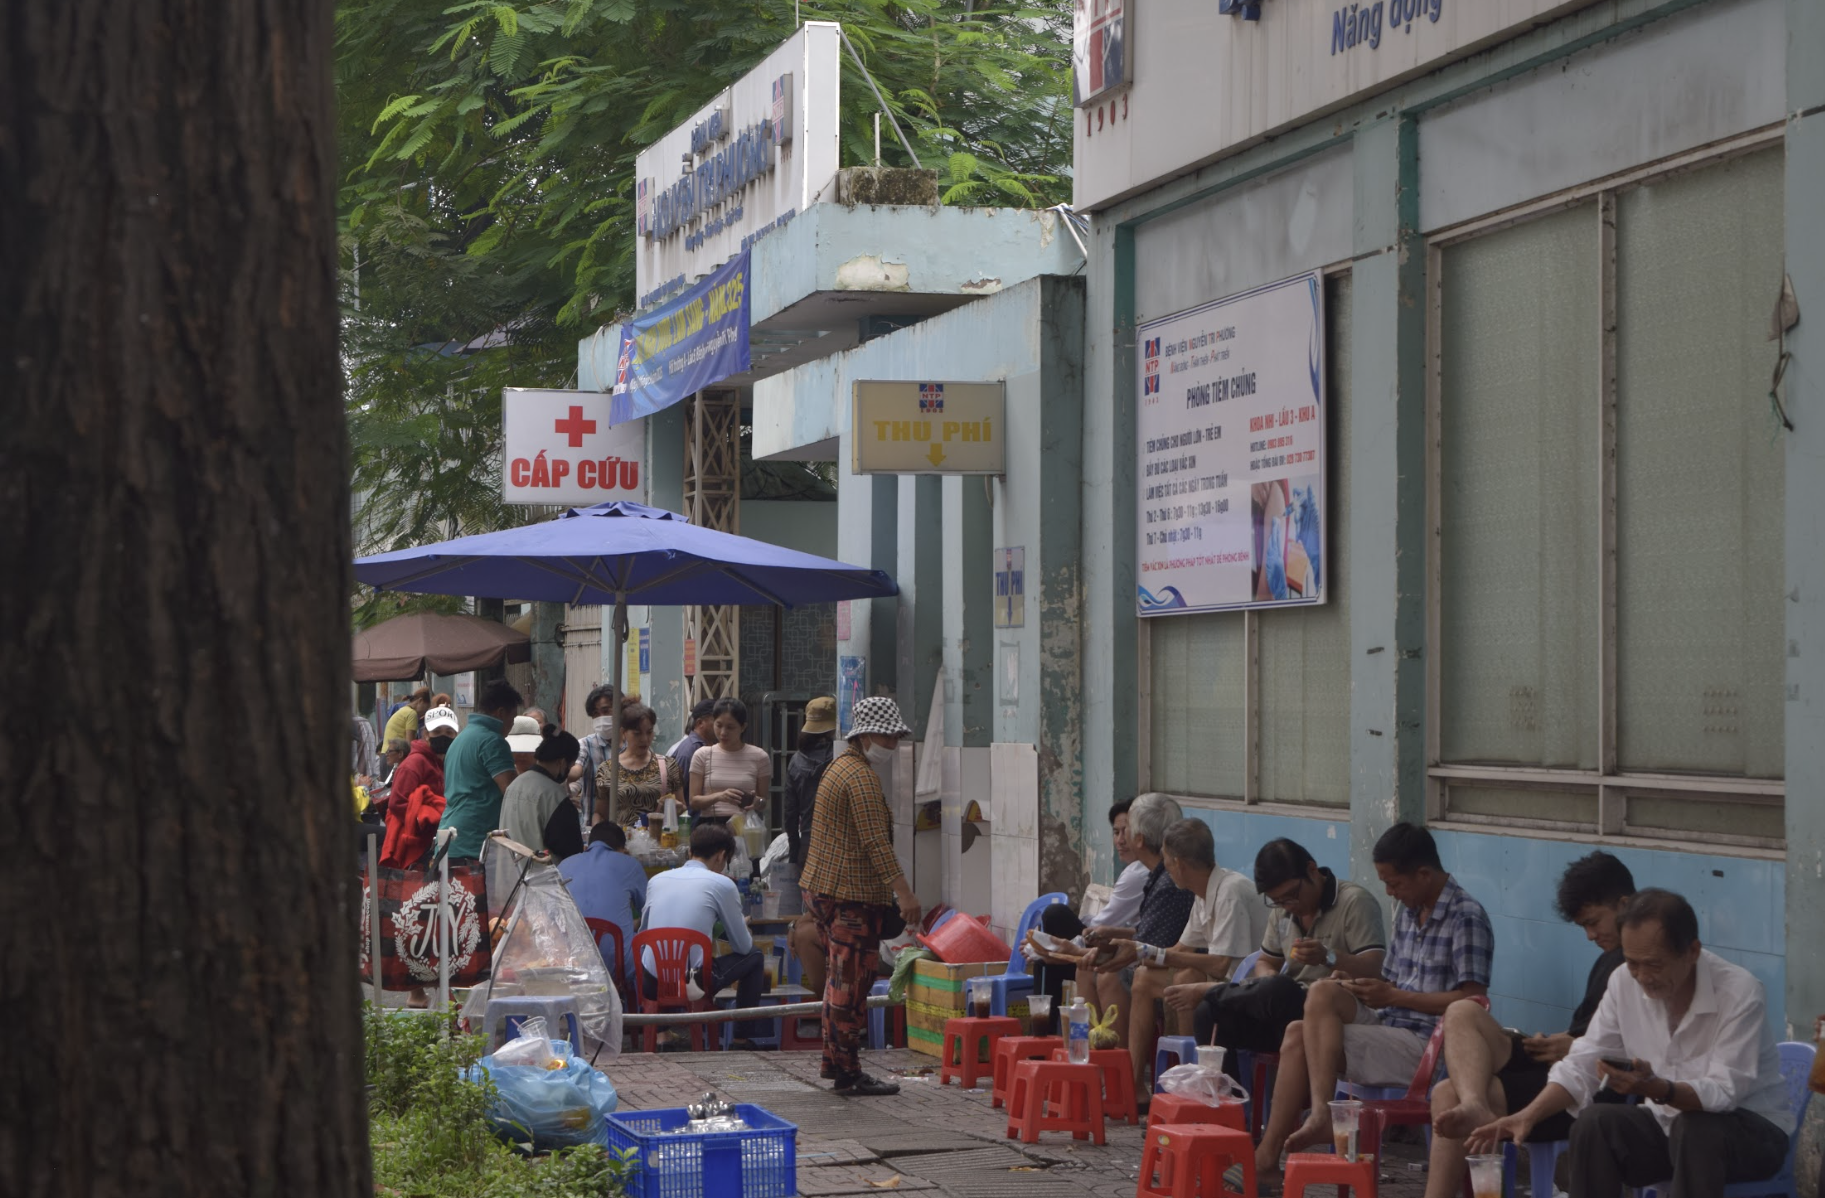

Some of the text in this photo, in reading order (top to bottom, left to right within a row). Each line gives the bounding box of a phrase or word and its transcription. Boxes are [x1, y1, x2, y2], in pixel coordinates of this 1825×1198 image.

[1331, 1, 1383, 56] Năng
[1087, 92, 1128, 137] 1903
[1188, 329, 1207, 351] NGUYỄN
[1145, 359, 1159, 374] NTP
[1186, 367, 1256, 410] PHÒNG TIÊM CHỦNG
[873, 417, 992, 442] THU PHÍ
[1249, 415, 1264, 433] KHOA
[1265, 413, 1274, 429] NHI
[1290, 409, 1294, 425] 3
[1298, 405, 1310, 423] KHU
[1310, 404, 1316, 421] A
[1146, 422, 1222, 454] TIÊM CHỦNG CHO NGƯỜI LỚN TRẺ EM
[1250, 440, 1266, 453] HOTLINE:
[511, 449, 639, 490] CẤP CỨU
[1160, 458, 1169, 475] CÁC
[1169, 458, 1179, 475] LOẠI
[1179, 452, 1188, 471] VẮC
[1188, 455, 1196, 470] XIN
[1146, 484, 1154, 500] LÀM
[1155, 482, 1164, 501] VIỆC
[1164, 478, 1172, 497] TẤT
[1179, 478, 1188, 495] CÁC
[1188, 476, 1200, 493] NGÀY
[1200, 475, 1215, 491] TRONG
[1159, 507, 1167, 521] Thứ
[1193, 526, 1202, 540] 11g
[996, 571, 1009, 596] THU
